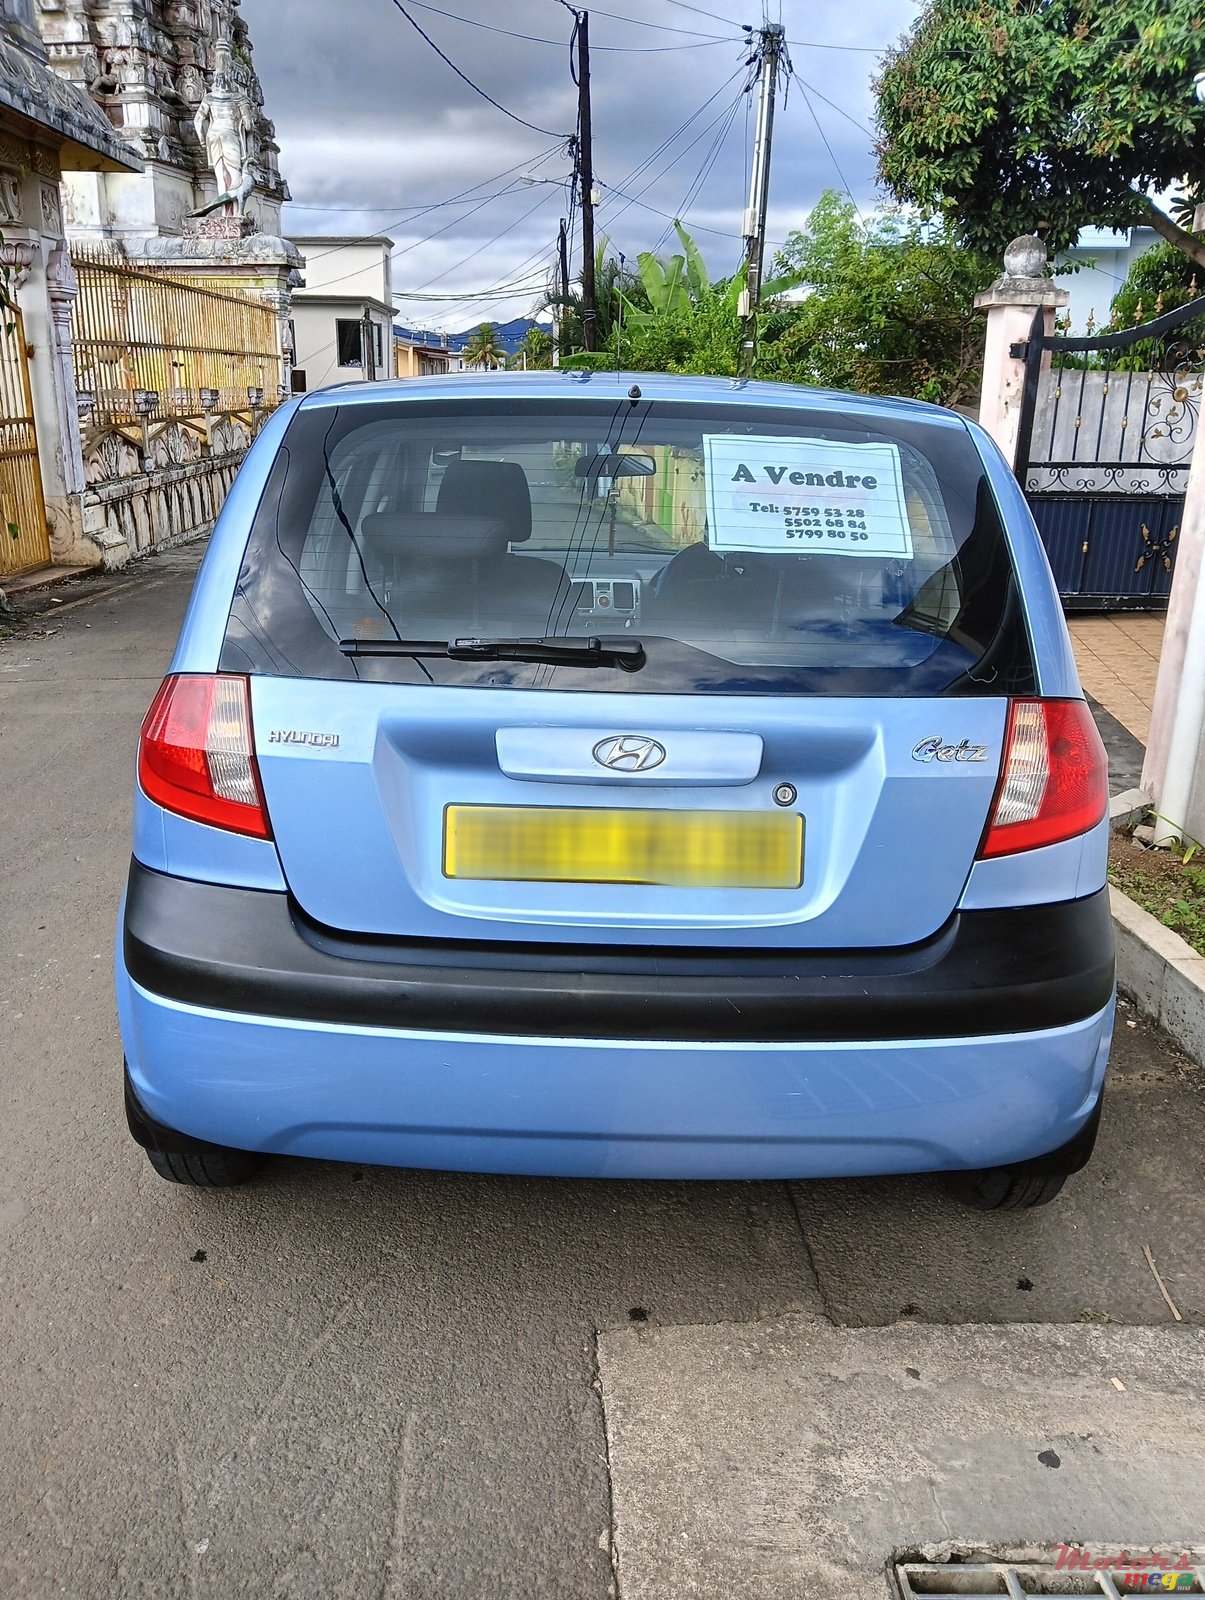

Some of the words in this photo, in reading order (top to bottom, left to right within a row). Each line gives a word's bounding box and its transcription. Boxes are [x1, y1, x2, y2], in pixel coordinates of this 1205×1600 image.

[731, 463, 757, 483] A
[763, 464, 878, 490] Vendre
[749, 502, 780, 514] Tel:
[783, 506, 820, 517] 5759
[824, 507, 843, 518] 53
[846, 509, 865, 518] 28
[784, 518, 822, 528] 5502
[825, 518, 844, 529] 68
[847, 519, 867, 531] 84
[785, 529, 824, 539] 5799
[827, 529, 846, 539] 80
[850, 530, 869, 541] 50
[268, 730, 340, 747] HYUNDAI
[911, 735, 989, 763] Getz
